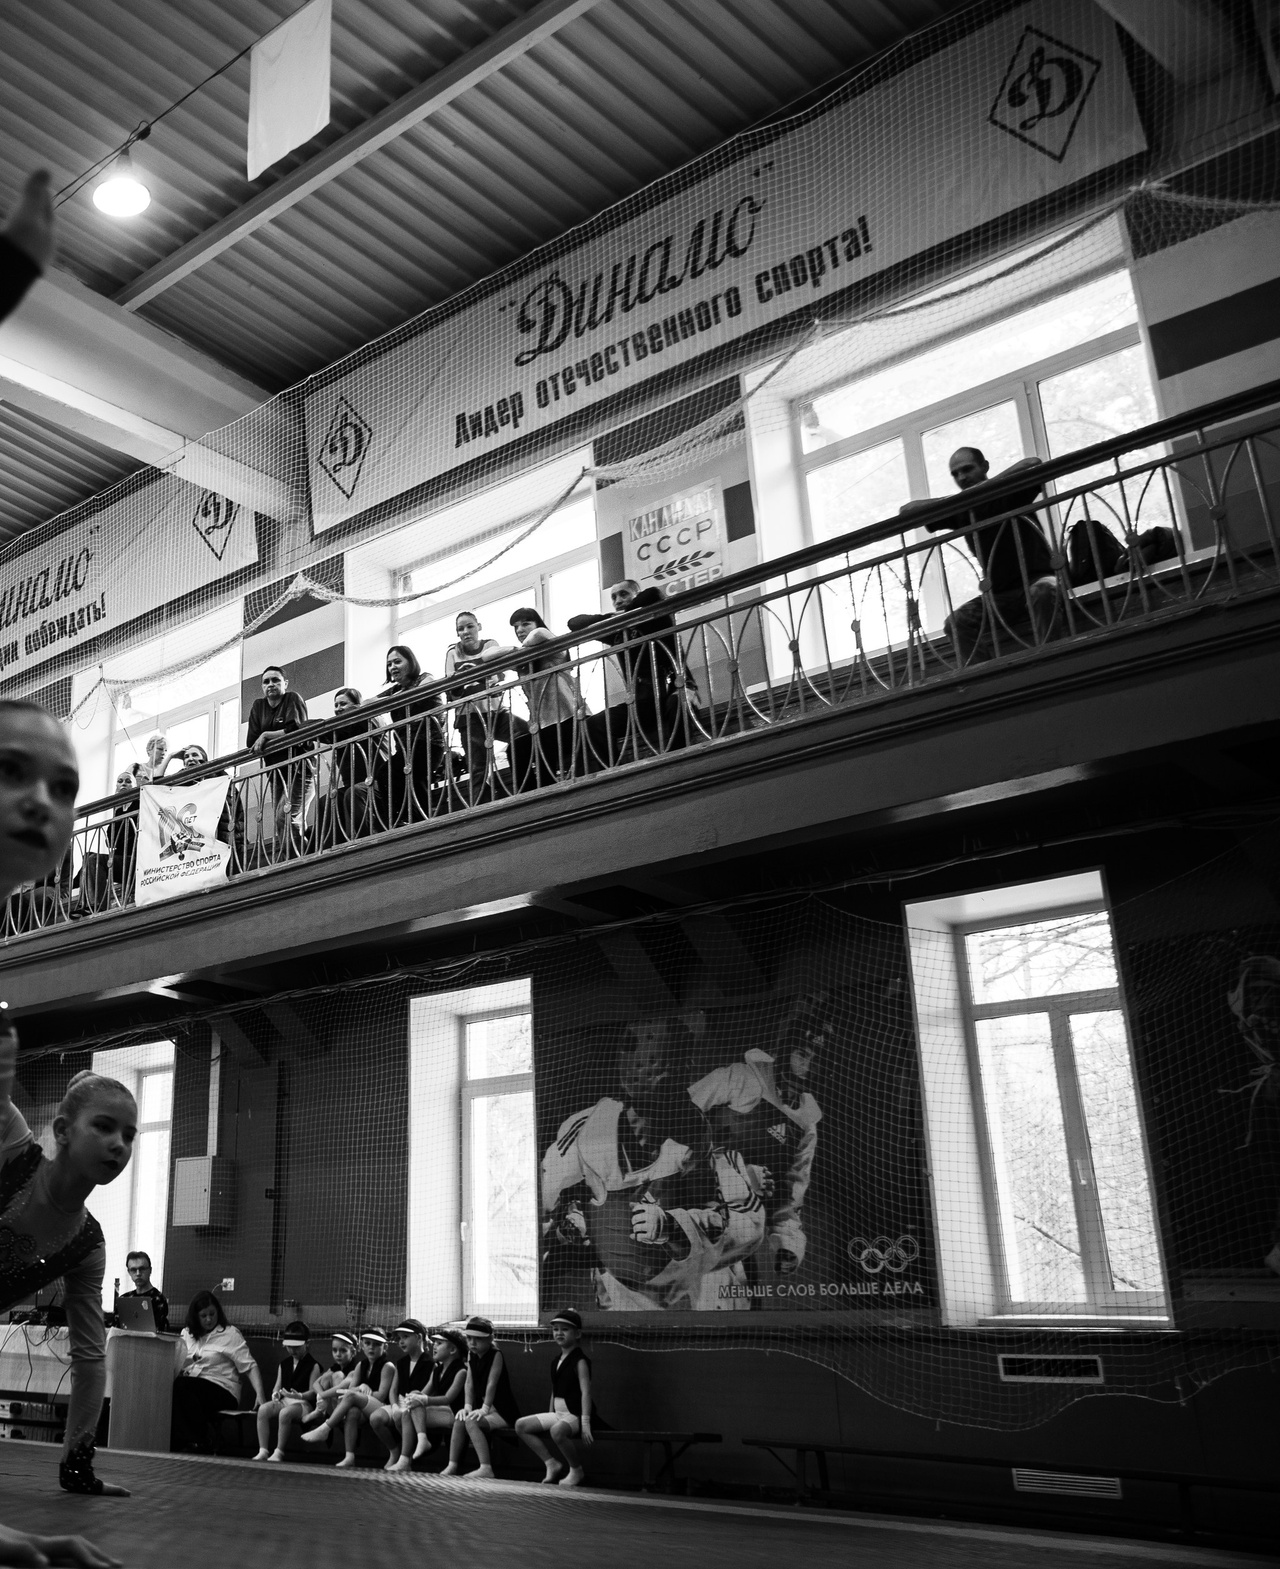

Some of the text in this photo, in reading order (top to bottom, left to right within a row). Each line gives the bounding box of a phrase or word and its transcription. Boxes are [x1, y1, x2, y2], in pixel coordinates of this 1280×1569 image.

[454, 214, 873, 449] Лидер отечественного спорта!
[637, 518, 713, 561] СССР
[665, 565, 722, 596] СТЕР
[24, 591, 107, 655] побеждать!
[144, 854, 221, 876] МИНИСТЕРСТВО СПОРТА
[719, 1281, 924, 1298] МЕНЬШЕ СЛОВ БОЛЬШЕ ДЕЛА
